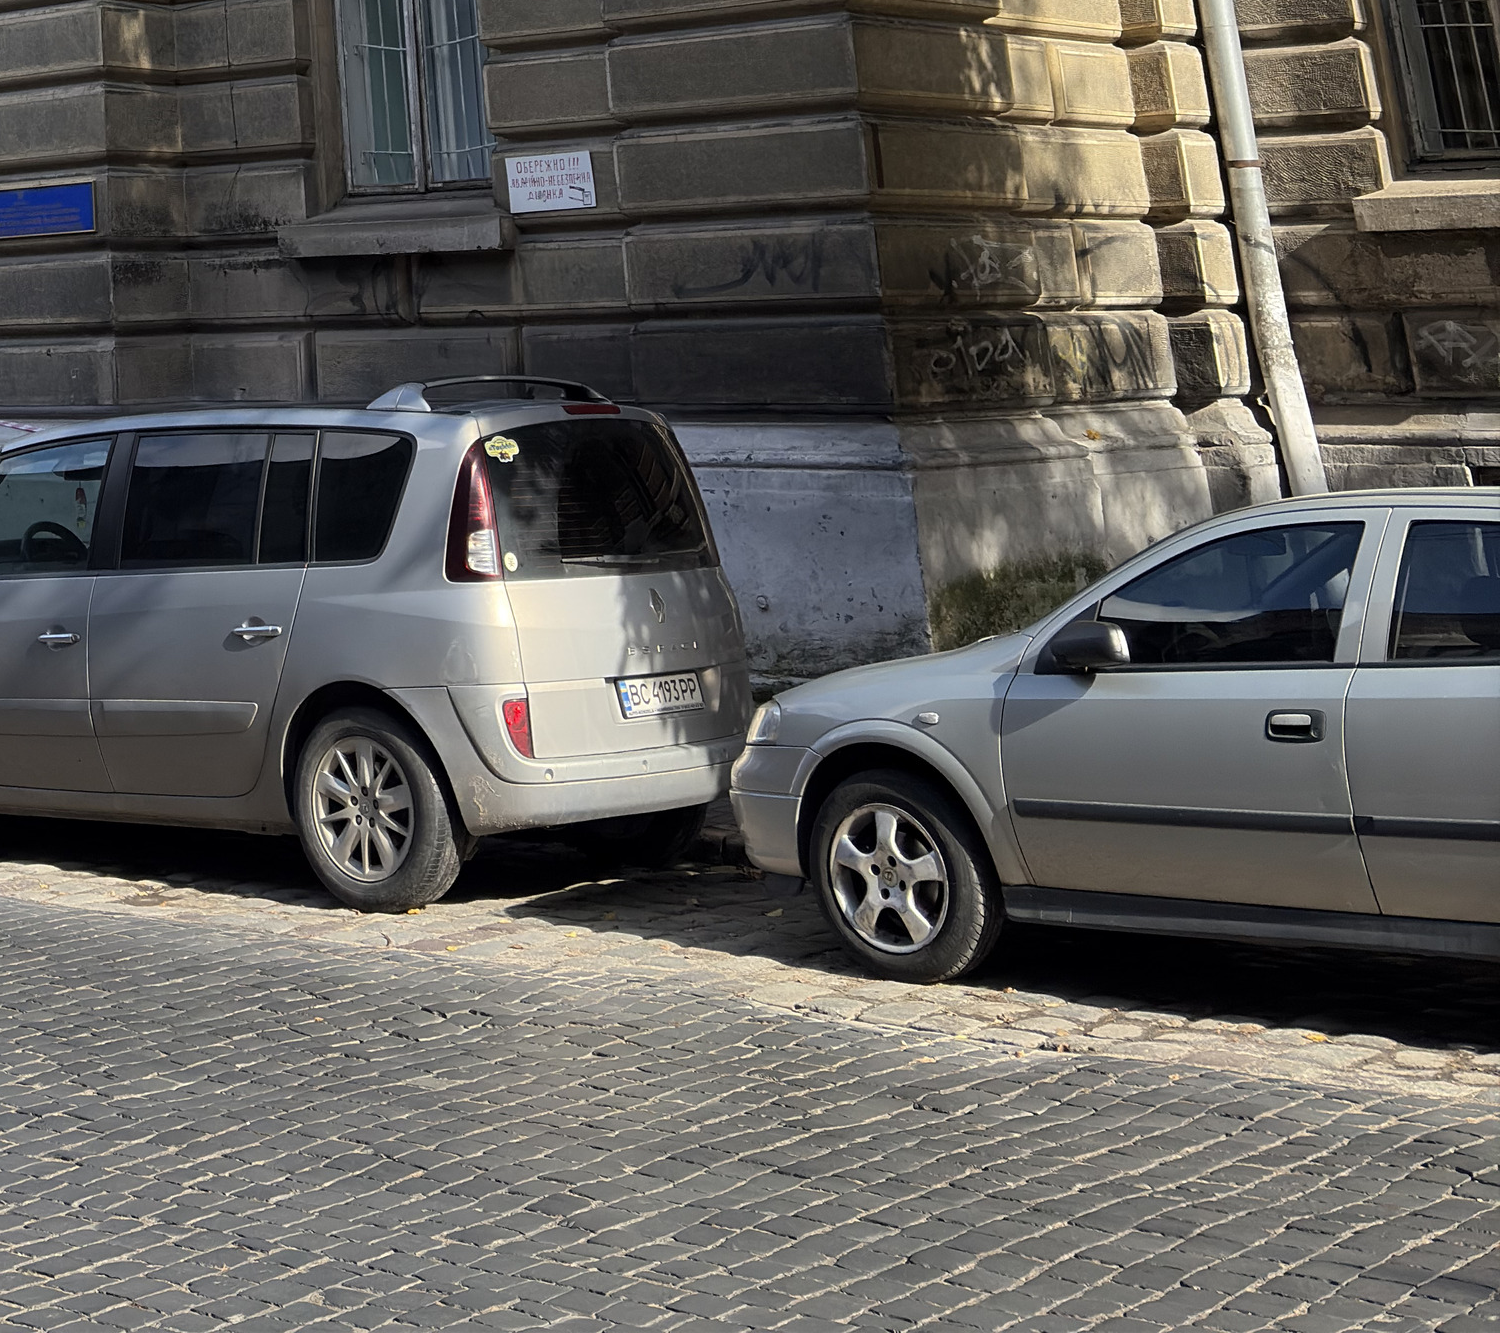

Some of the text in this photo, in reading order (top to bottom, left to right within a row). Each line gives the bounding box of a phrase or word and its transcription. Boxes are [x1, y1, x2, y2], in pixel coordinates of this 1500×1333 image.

[516, 158, 565, 174] ОБЕРЕЖНО
[628, 678, 697, 707] BC 4193 PP
